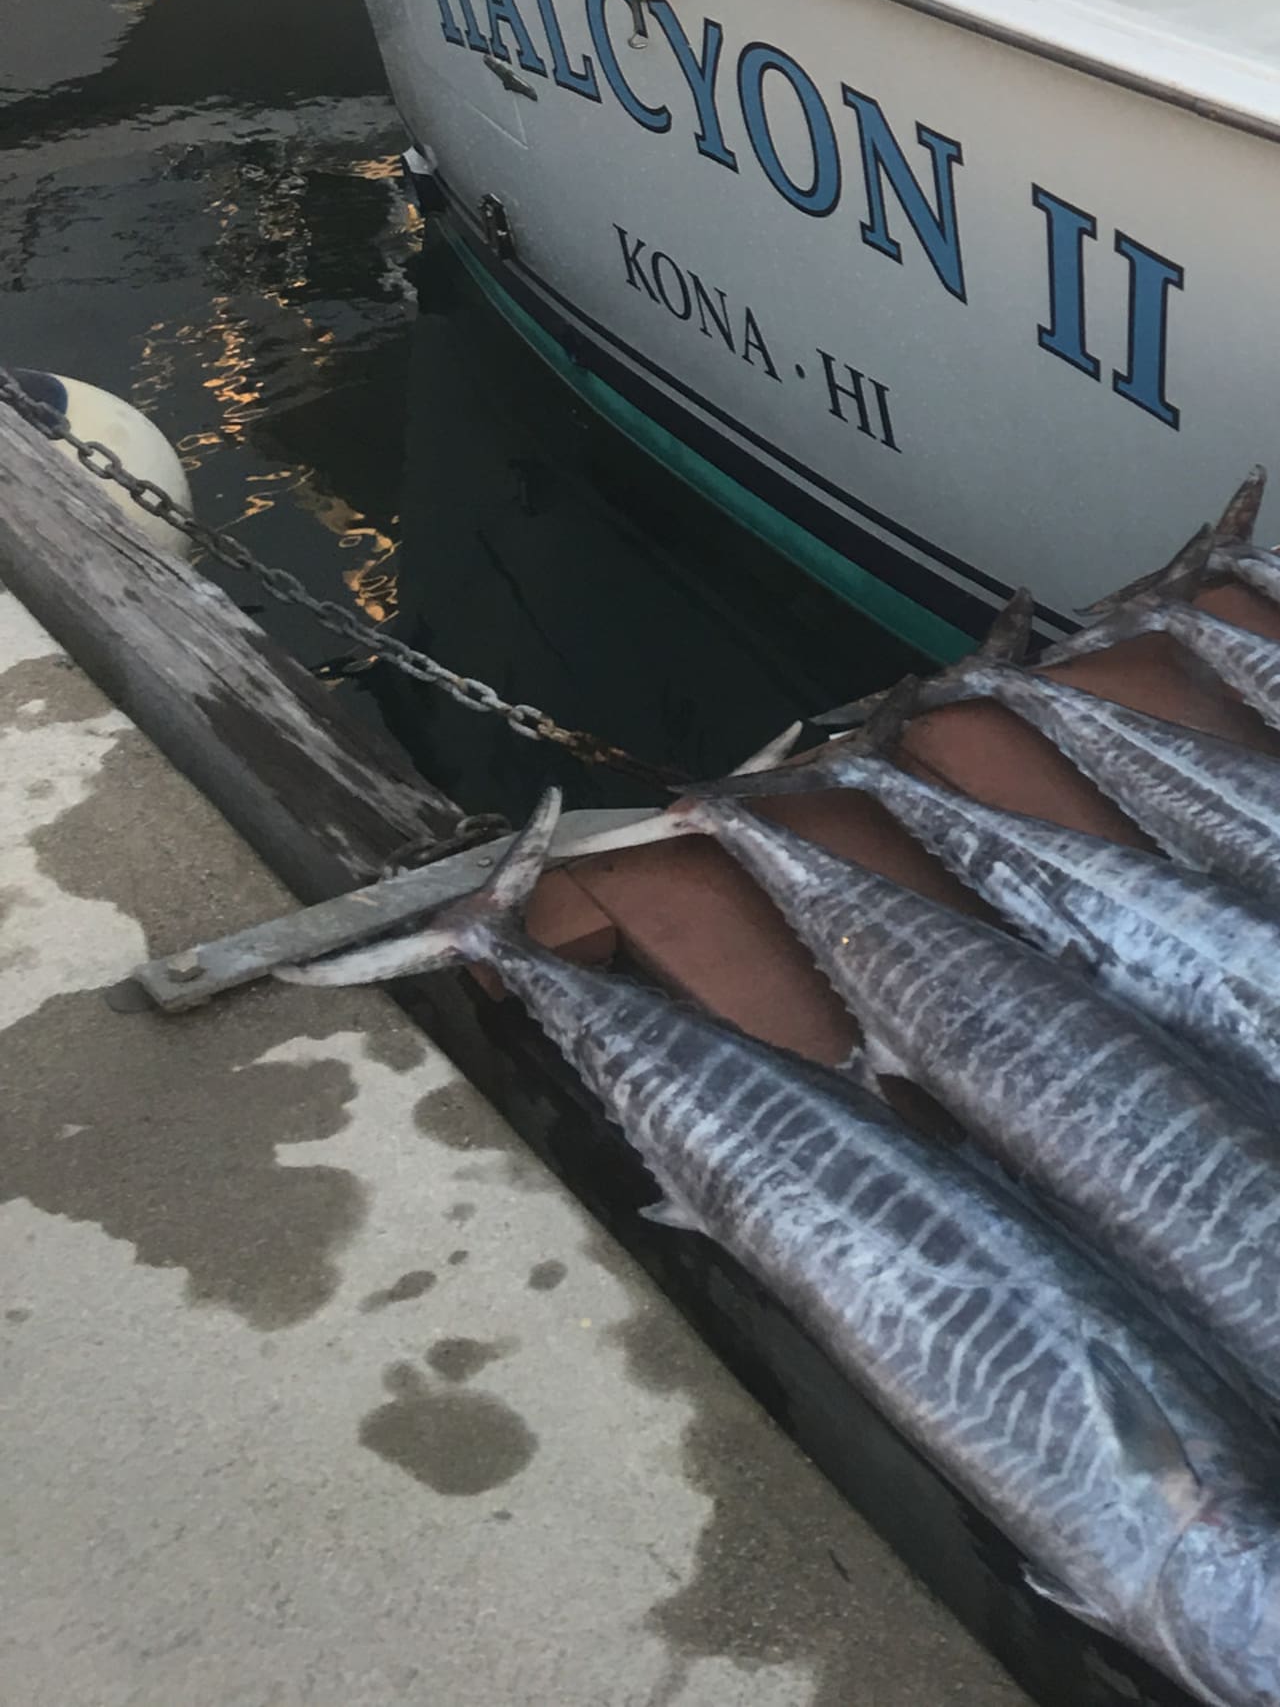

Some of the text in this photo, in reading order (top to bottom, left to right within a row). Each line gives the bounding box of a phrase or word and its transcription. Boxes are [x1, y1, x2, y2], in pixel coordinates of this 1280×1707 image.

[611, 222, 903, 454] KONA HI
[1031, 182, 1186, 432] II
